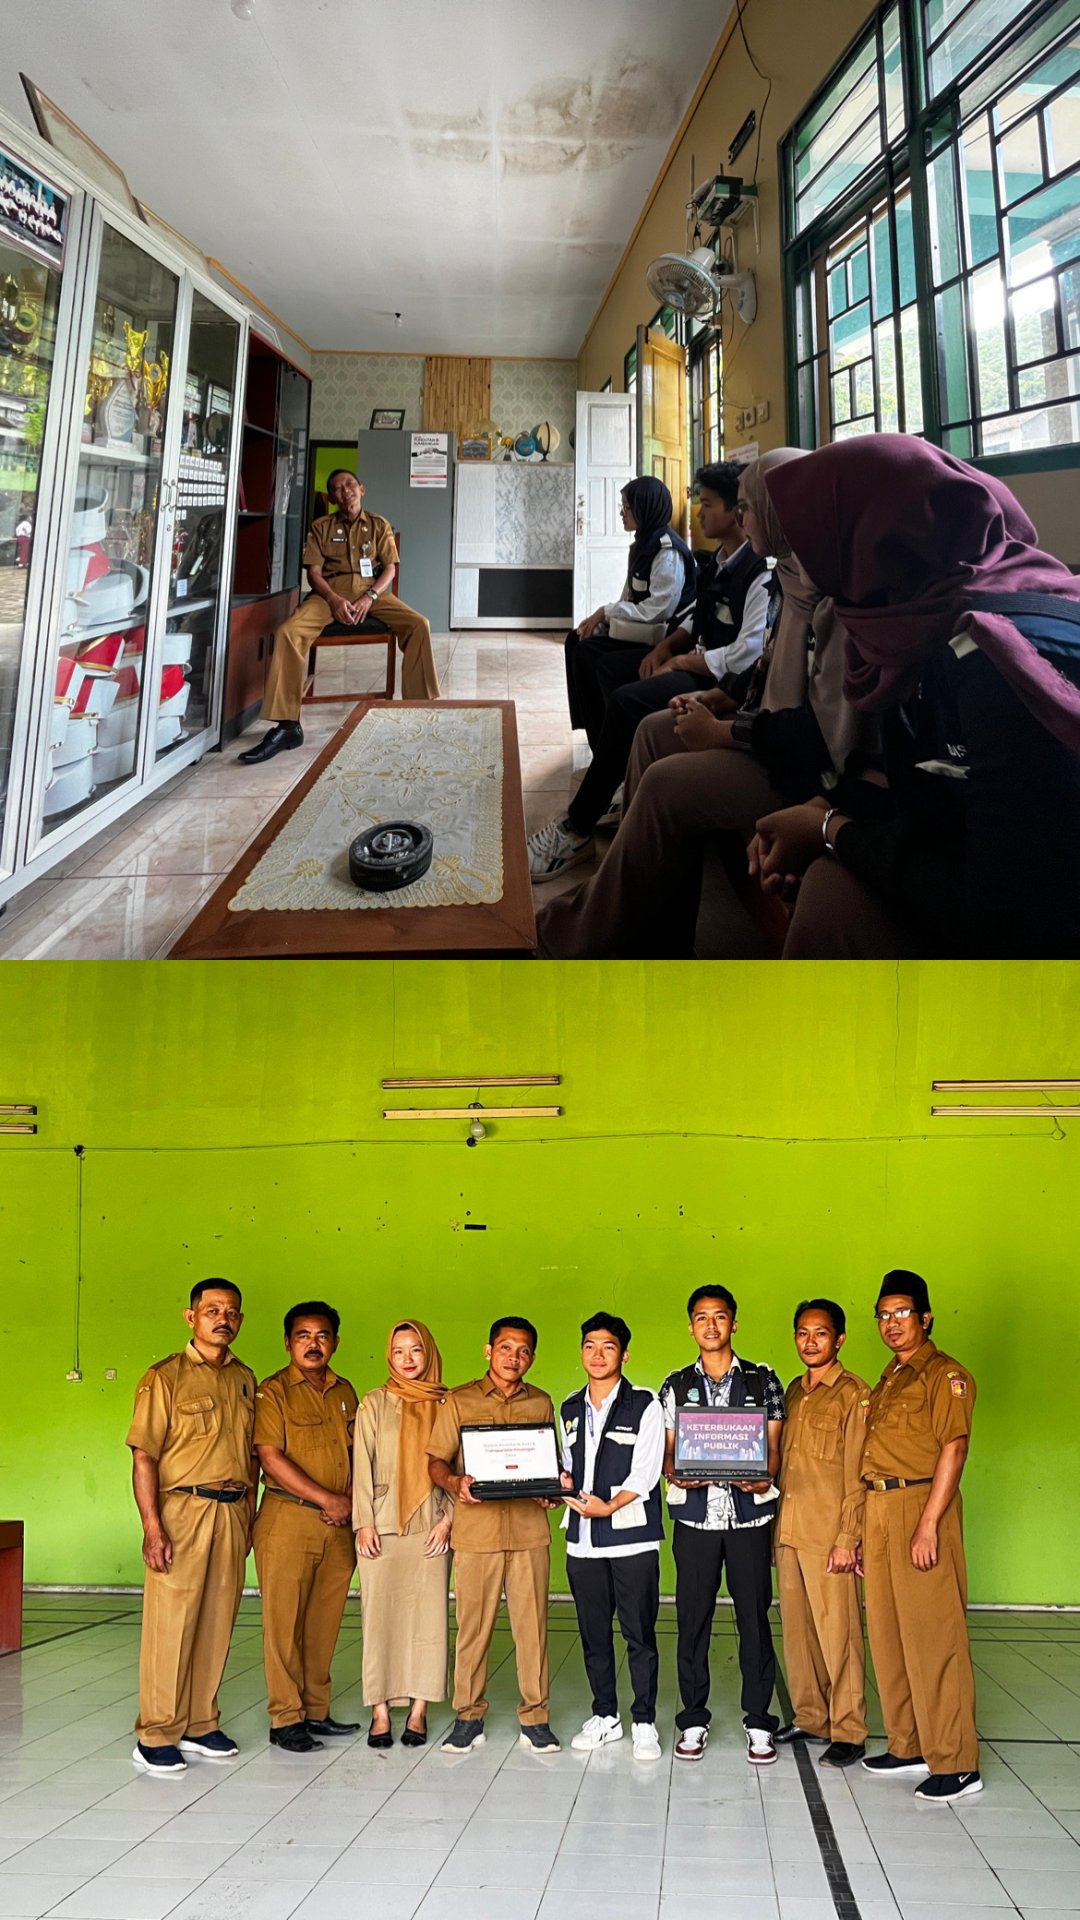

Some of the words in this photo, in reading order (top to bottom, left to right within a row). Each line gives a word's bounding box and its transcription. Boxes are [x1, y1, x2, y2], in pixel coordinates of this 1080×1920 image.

[686, 1423, 756, 1432] KETERBUKAAN
[693, 1433, 749, 1441] INFORMASI
[703, 1442, 739, 1450] PUBLIK
